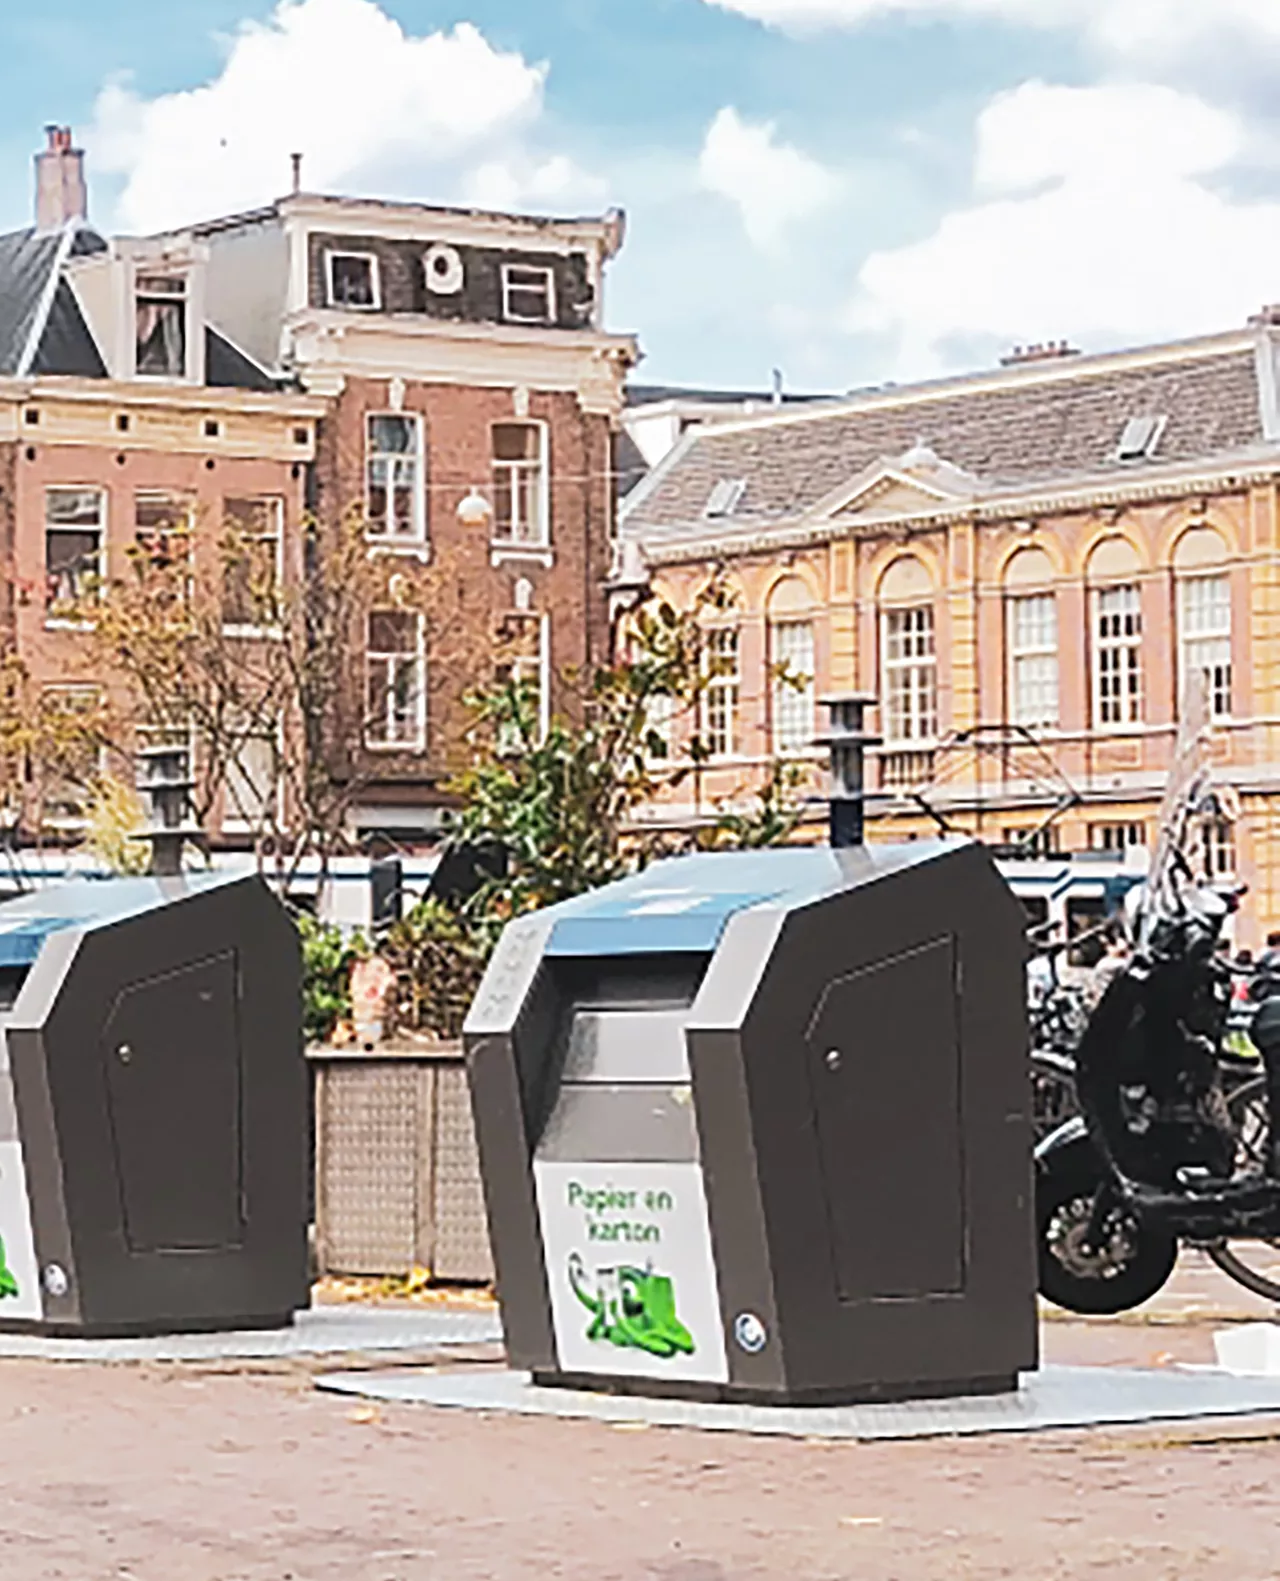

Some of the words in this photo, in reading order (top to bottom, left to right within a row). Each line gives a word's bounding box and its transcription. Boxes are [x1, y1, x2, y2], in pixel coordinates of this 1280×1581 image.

[567, 1180, 638, 1217] Papier
[644, 1189, 673, 1212] en
[584, 1212, 661, 1243] karton
